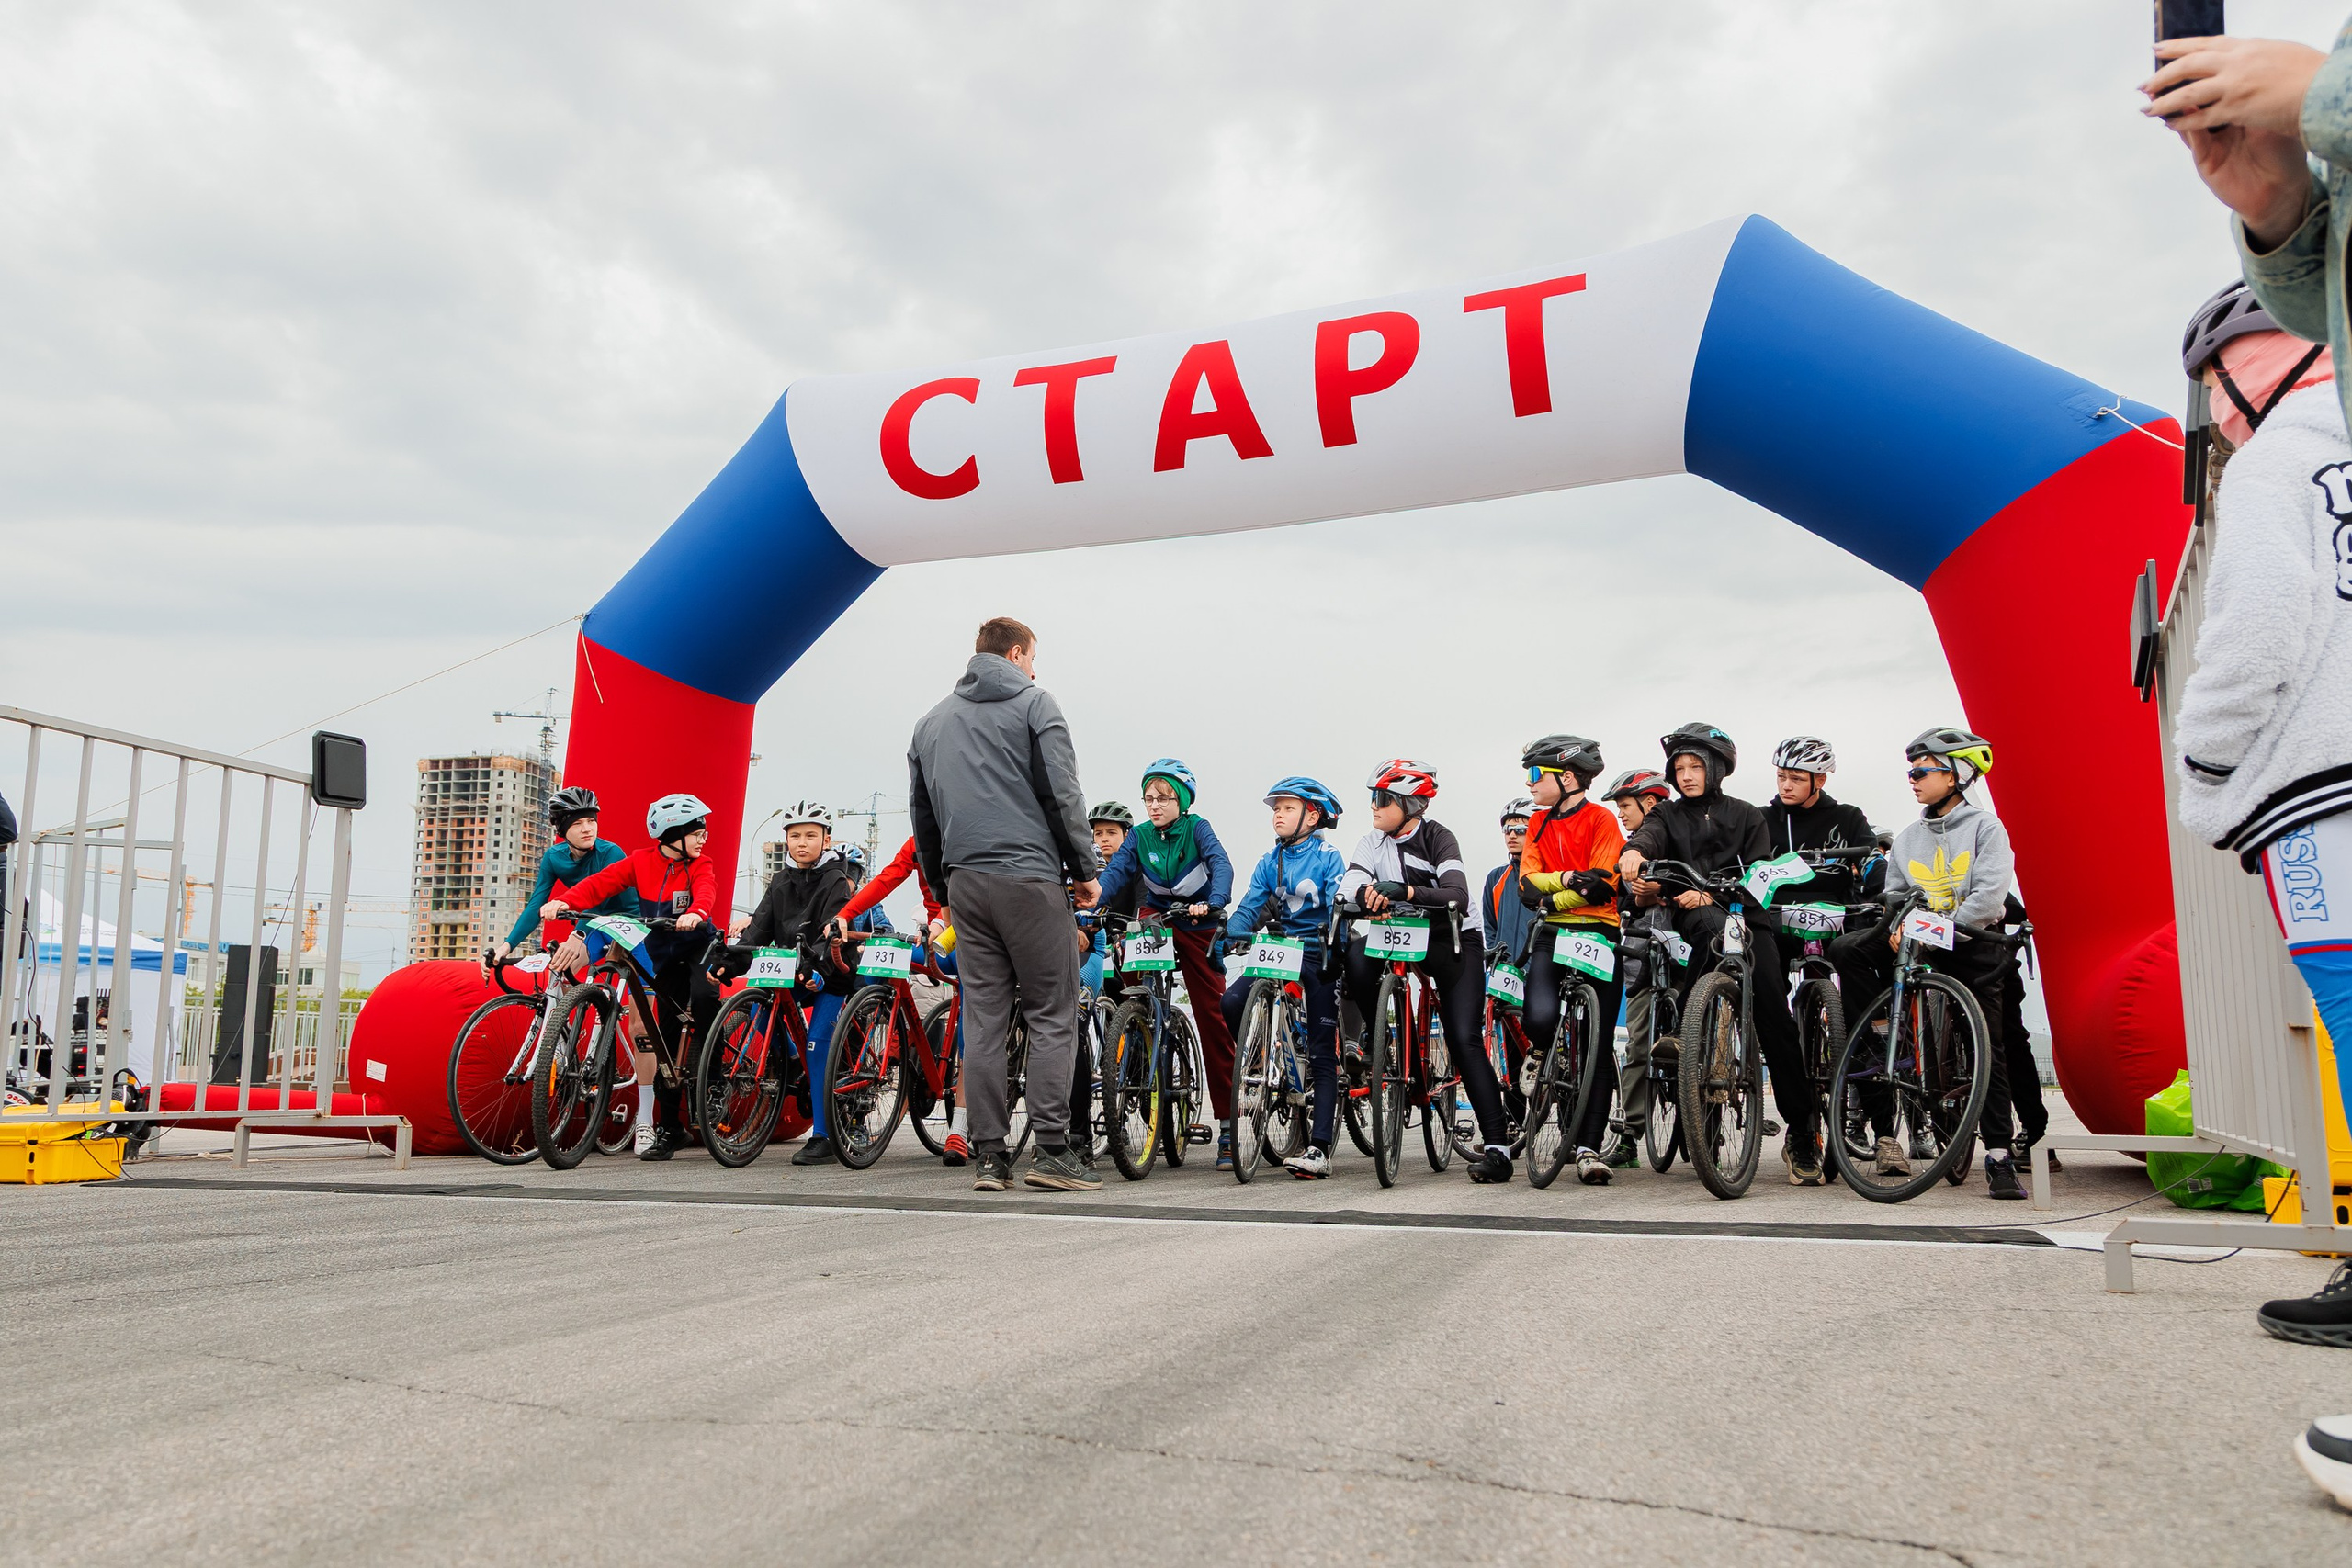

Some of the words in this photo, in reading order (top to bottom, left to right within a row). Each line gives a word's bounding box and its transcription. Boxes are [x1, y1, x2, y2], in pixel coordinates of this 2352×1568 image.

[879, 273, 1588, 500] СТАРТ
[1758, 867, 1790, 883] 865
[2278, 821, 2330, 923] RUS
[1798, 912, 1826, 927] 851
[1384, 931, 1412, 946] 852
[875, 951, 895, 964] 931
[1258, 949, 1285, 964] 849
[1574, 942, 1600, 962] 921
[759, 961, 782, 974] 894
